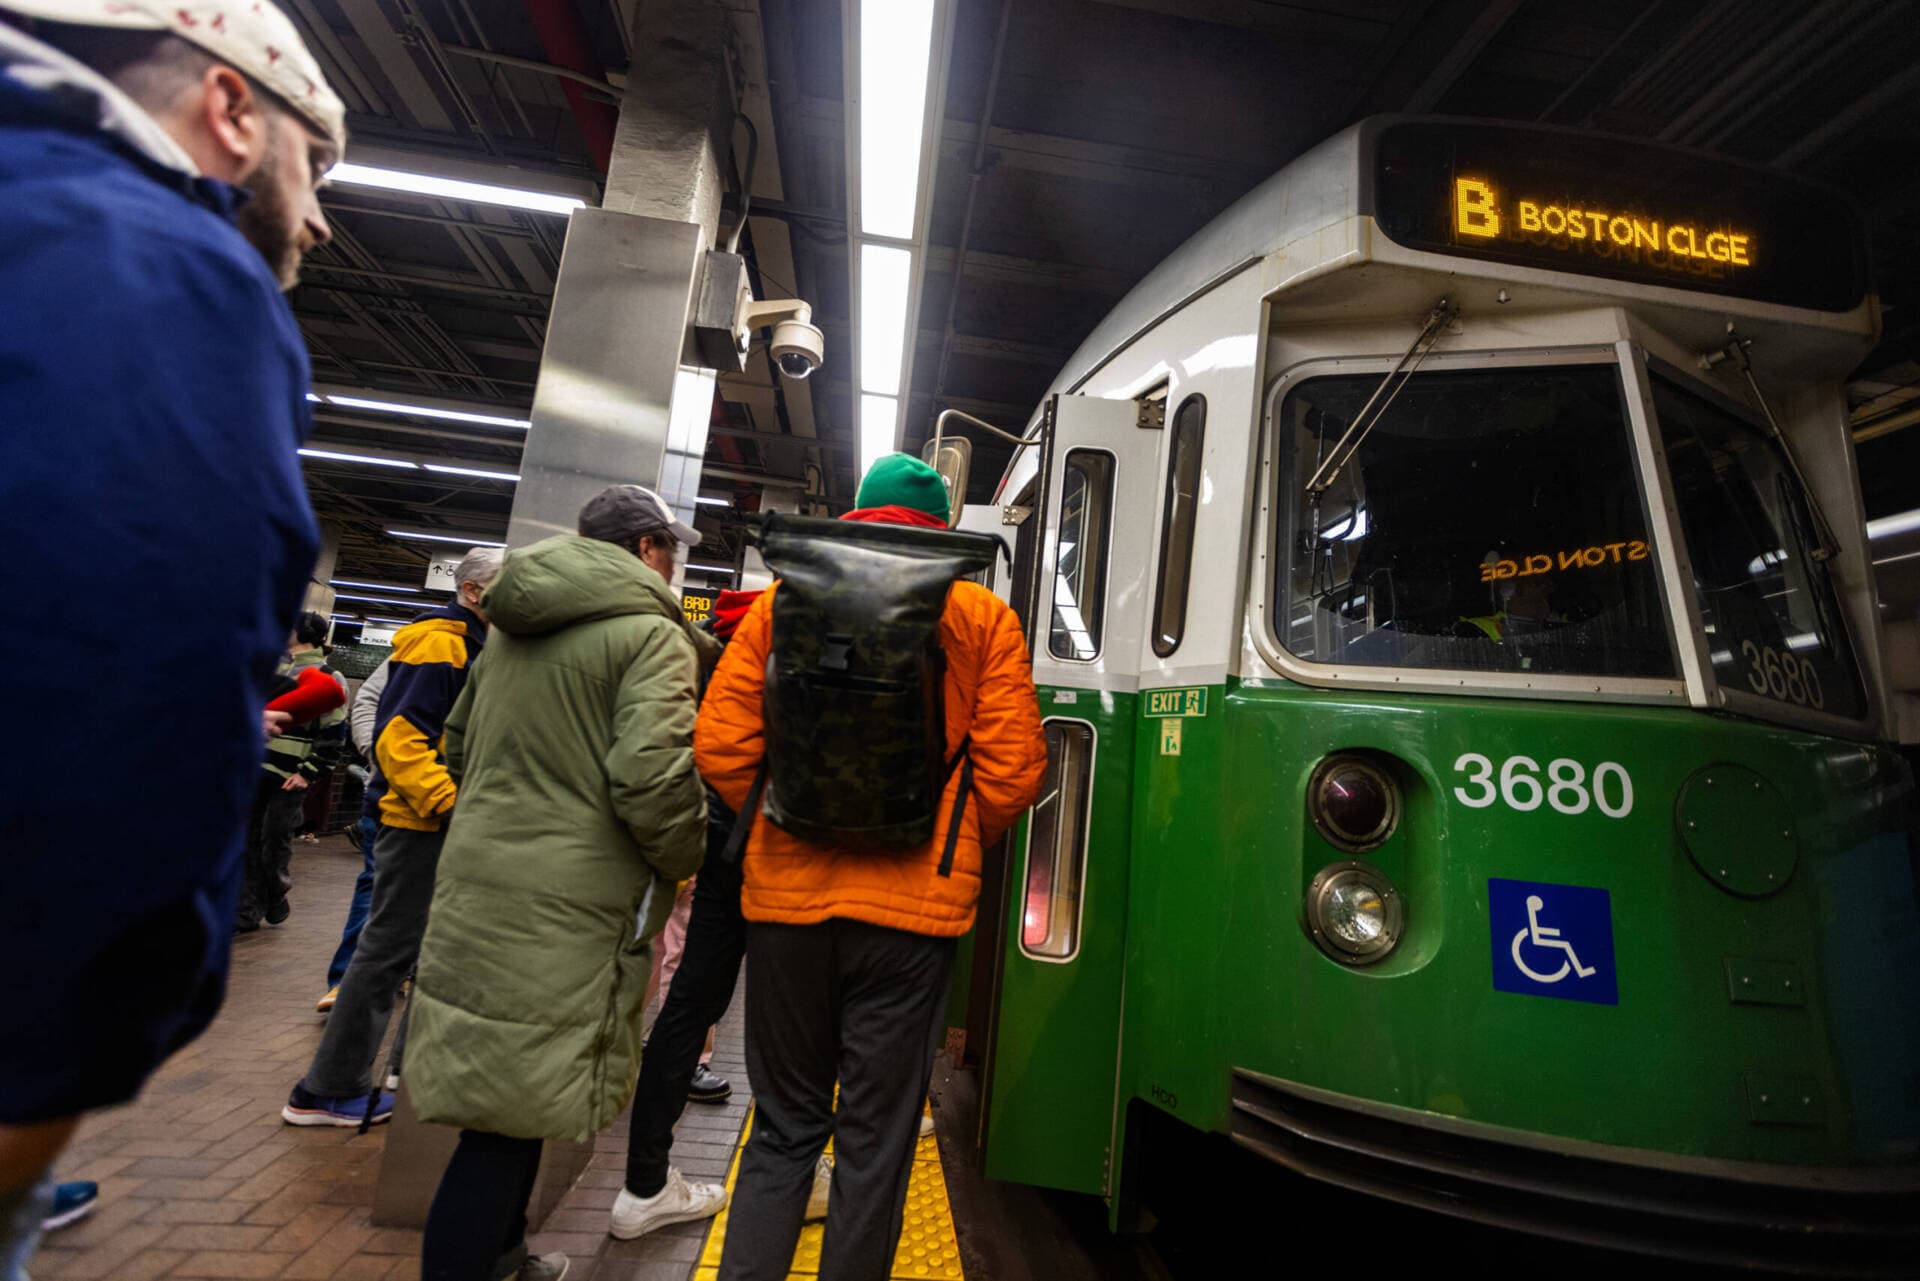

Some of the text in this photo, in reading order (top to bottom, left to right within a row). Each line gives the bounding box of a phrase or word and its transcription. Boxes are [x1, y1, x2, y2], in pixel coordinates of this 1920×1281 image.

[1457, 178, 1750, 266] B BOSTON CLGE
[683, 595, 711, 611] BRD
[1151, 692, 1182, 712] EXIT
[1742, 639, 1824, 710] 3680
[1454, 752, 1634, 818] 3680
